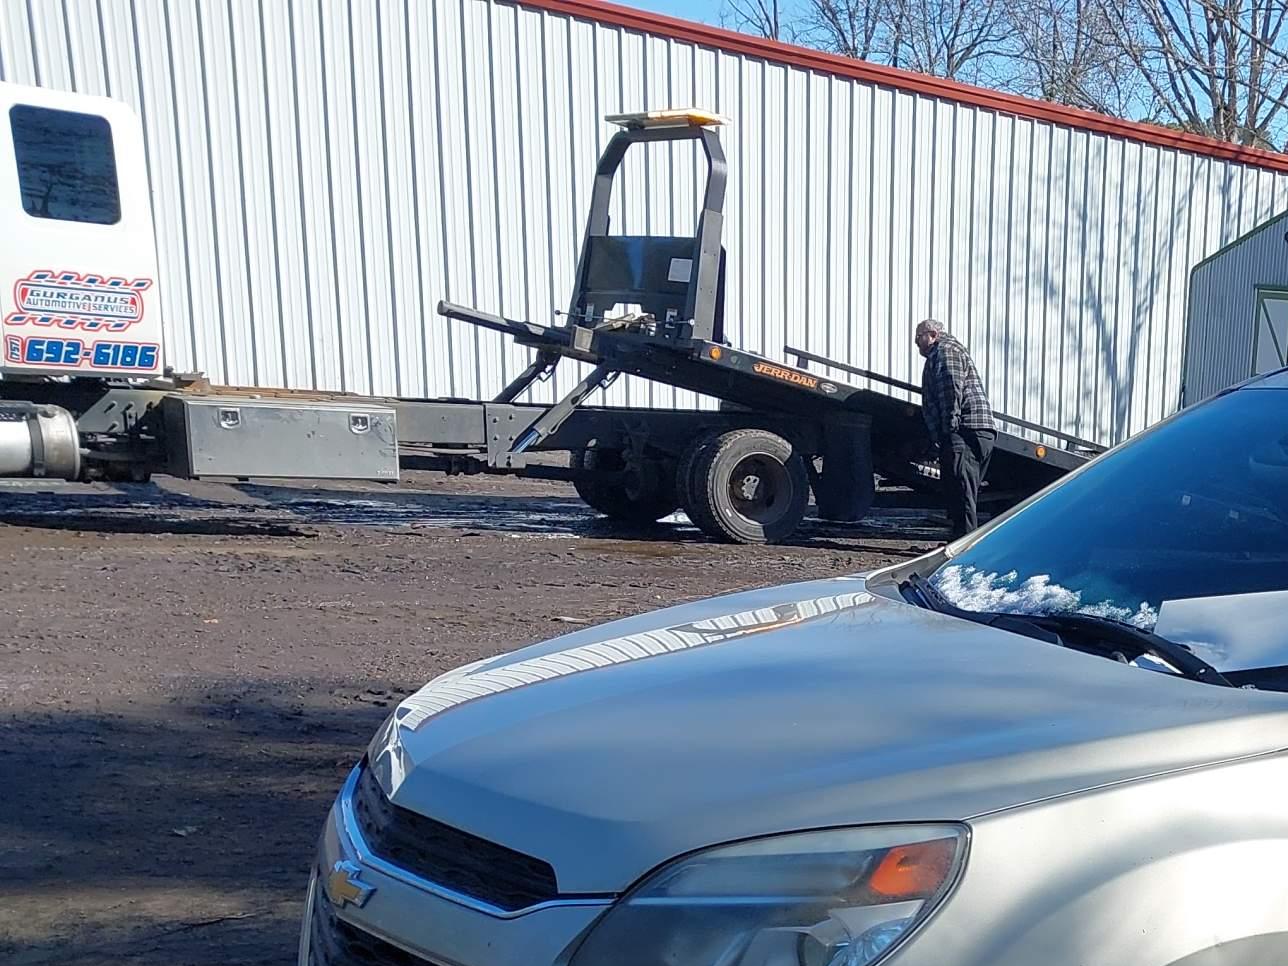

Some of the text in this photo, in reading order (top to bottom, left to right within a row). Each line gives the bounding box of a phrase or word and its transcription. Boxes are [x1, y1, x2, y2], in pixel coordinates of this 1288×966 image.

[29, 288, 129, 305] GURGANUS
[26, 297, 135, 314] AUTOMOTIVE SERVICES
[26, 340, 157, 367] 692-6186
